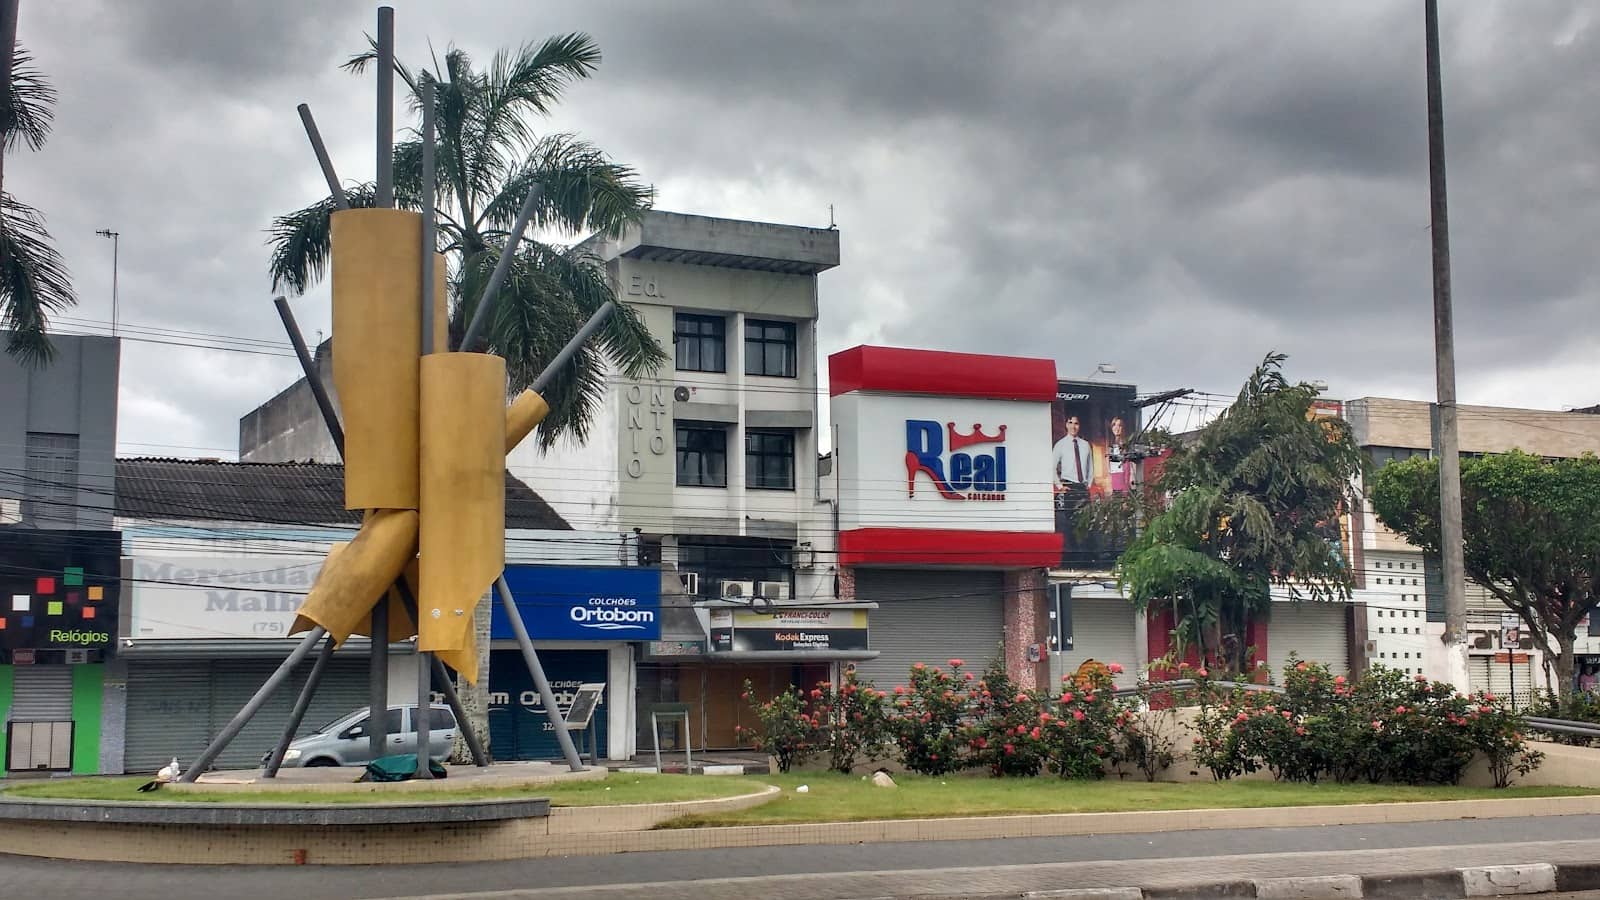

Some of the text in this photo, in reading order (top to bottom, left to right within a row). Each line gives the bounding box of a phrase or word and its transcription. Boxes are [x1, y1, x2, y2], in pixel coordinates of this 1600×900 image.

[905, 420, 1007, 496] Real
[204, 590, 300, 612] Malh
[570, 606, 654, 622] Ortobom
[252, 622, 284, 633] (75)
[50, 629, 109, 645] Relógios
[775, 633, 829, 642] Kodak Express
